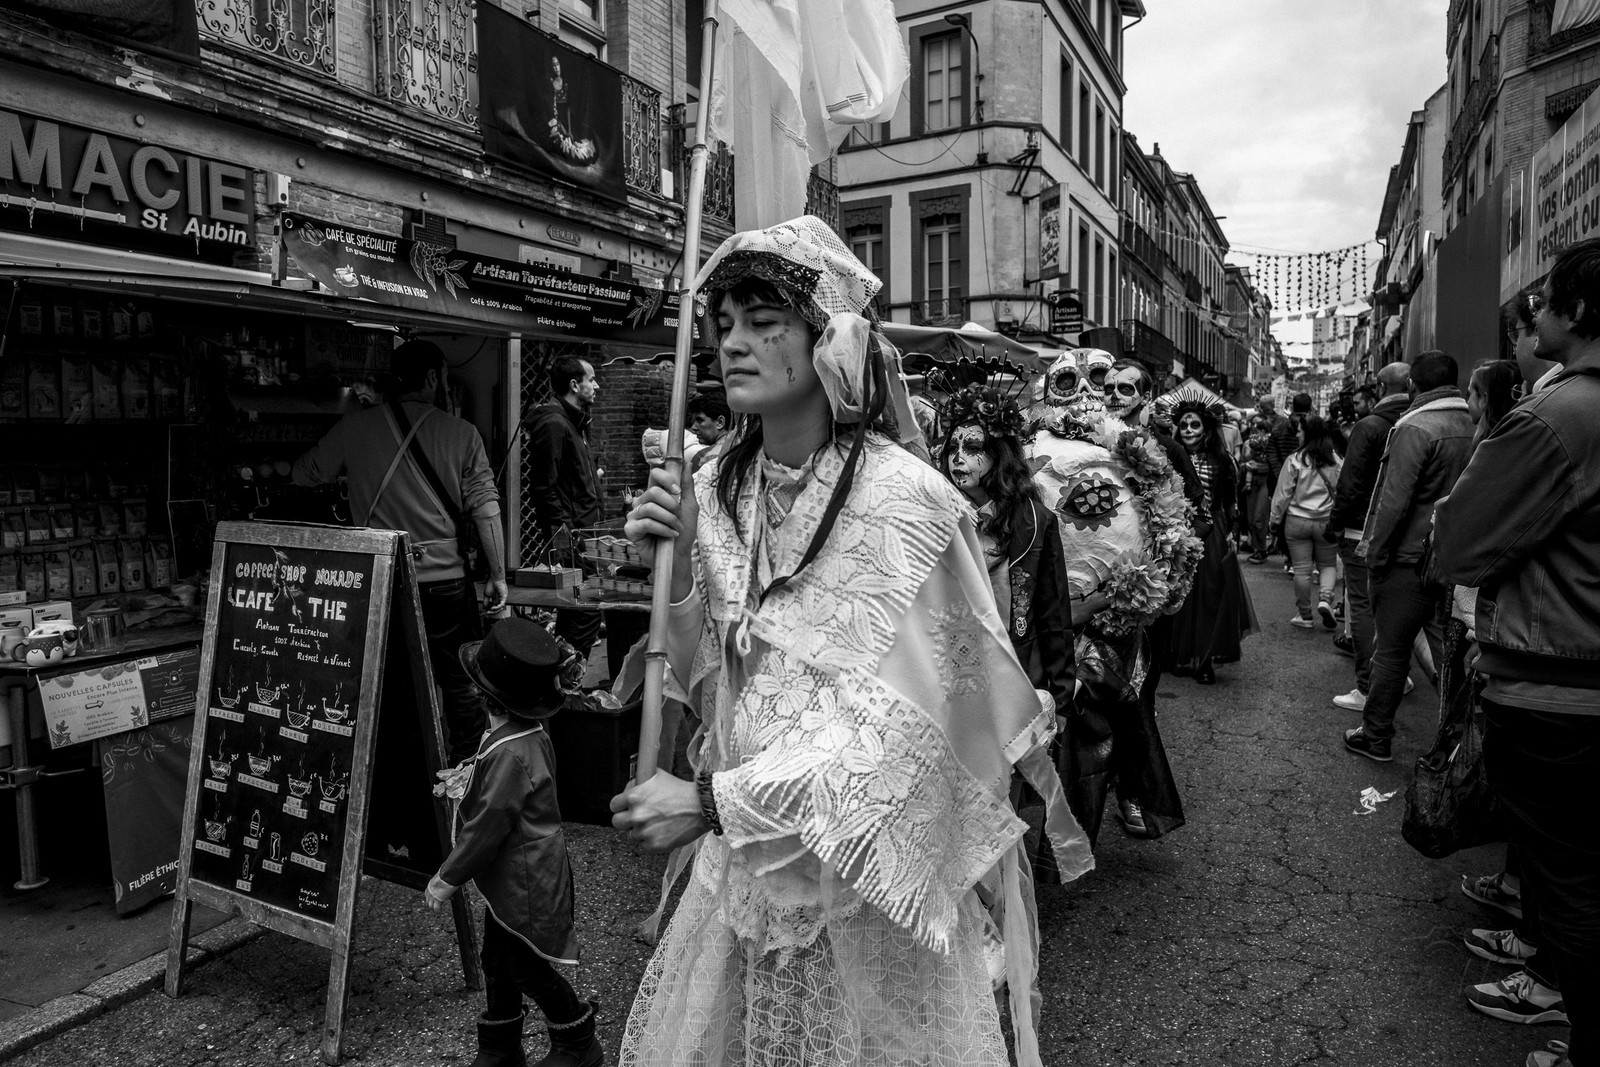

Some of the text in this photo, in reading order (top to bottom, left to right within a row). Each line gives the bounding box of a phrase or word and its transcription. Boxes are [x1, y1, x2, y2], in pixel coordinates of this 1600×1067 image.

[1576, 122, 1600, 160] travau
[0, 110, 249, 225] MACIE
[1538, 190, 1557, 228] vos
[141, 208, 248, 245] St Aubin
[1536, 206, 1578, 266] restent
[325, 227, 398, 254] CAFÉ DE SPÉCIALITÉ
[360, 274, 372, 287] THÉ
[376, 279, 404, 295] INFUSION
[403, 285, 412, 296] EN
[411, 287, 429, 299] VRAC
[472, 262, 520, 282] Artisan
[521, 270, 588, 294] Torréfacteur
[588, 283, 632, 301] Passionné
[470, 297, 485, 306] Café
[501, 302, 523, 312] Arabica
[554, 299, 561, 307] et
[561, 301, 592, 312] transparence
[1054, 306, 1078, 314] Artisan
[1054, 313, 1082, 321] Boulanger
[537, 316, 577, 330] Filière éthique
[235, 562, 364, 589] COFFEE SHOP NOMADE
[235, 588, 347, 621] CAFE THE
[48, 686, 94, 702] NOUVELLES
[96, 678, 134, 691] CAPSULES
[87, 693, 105, 701] Encore
[118, 685, 138, 693] Intense
[129, 871, 155, 891] FILIÈRE
